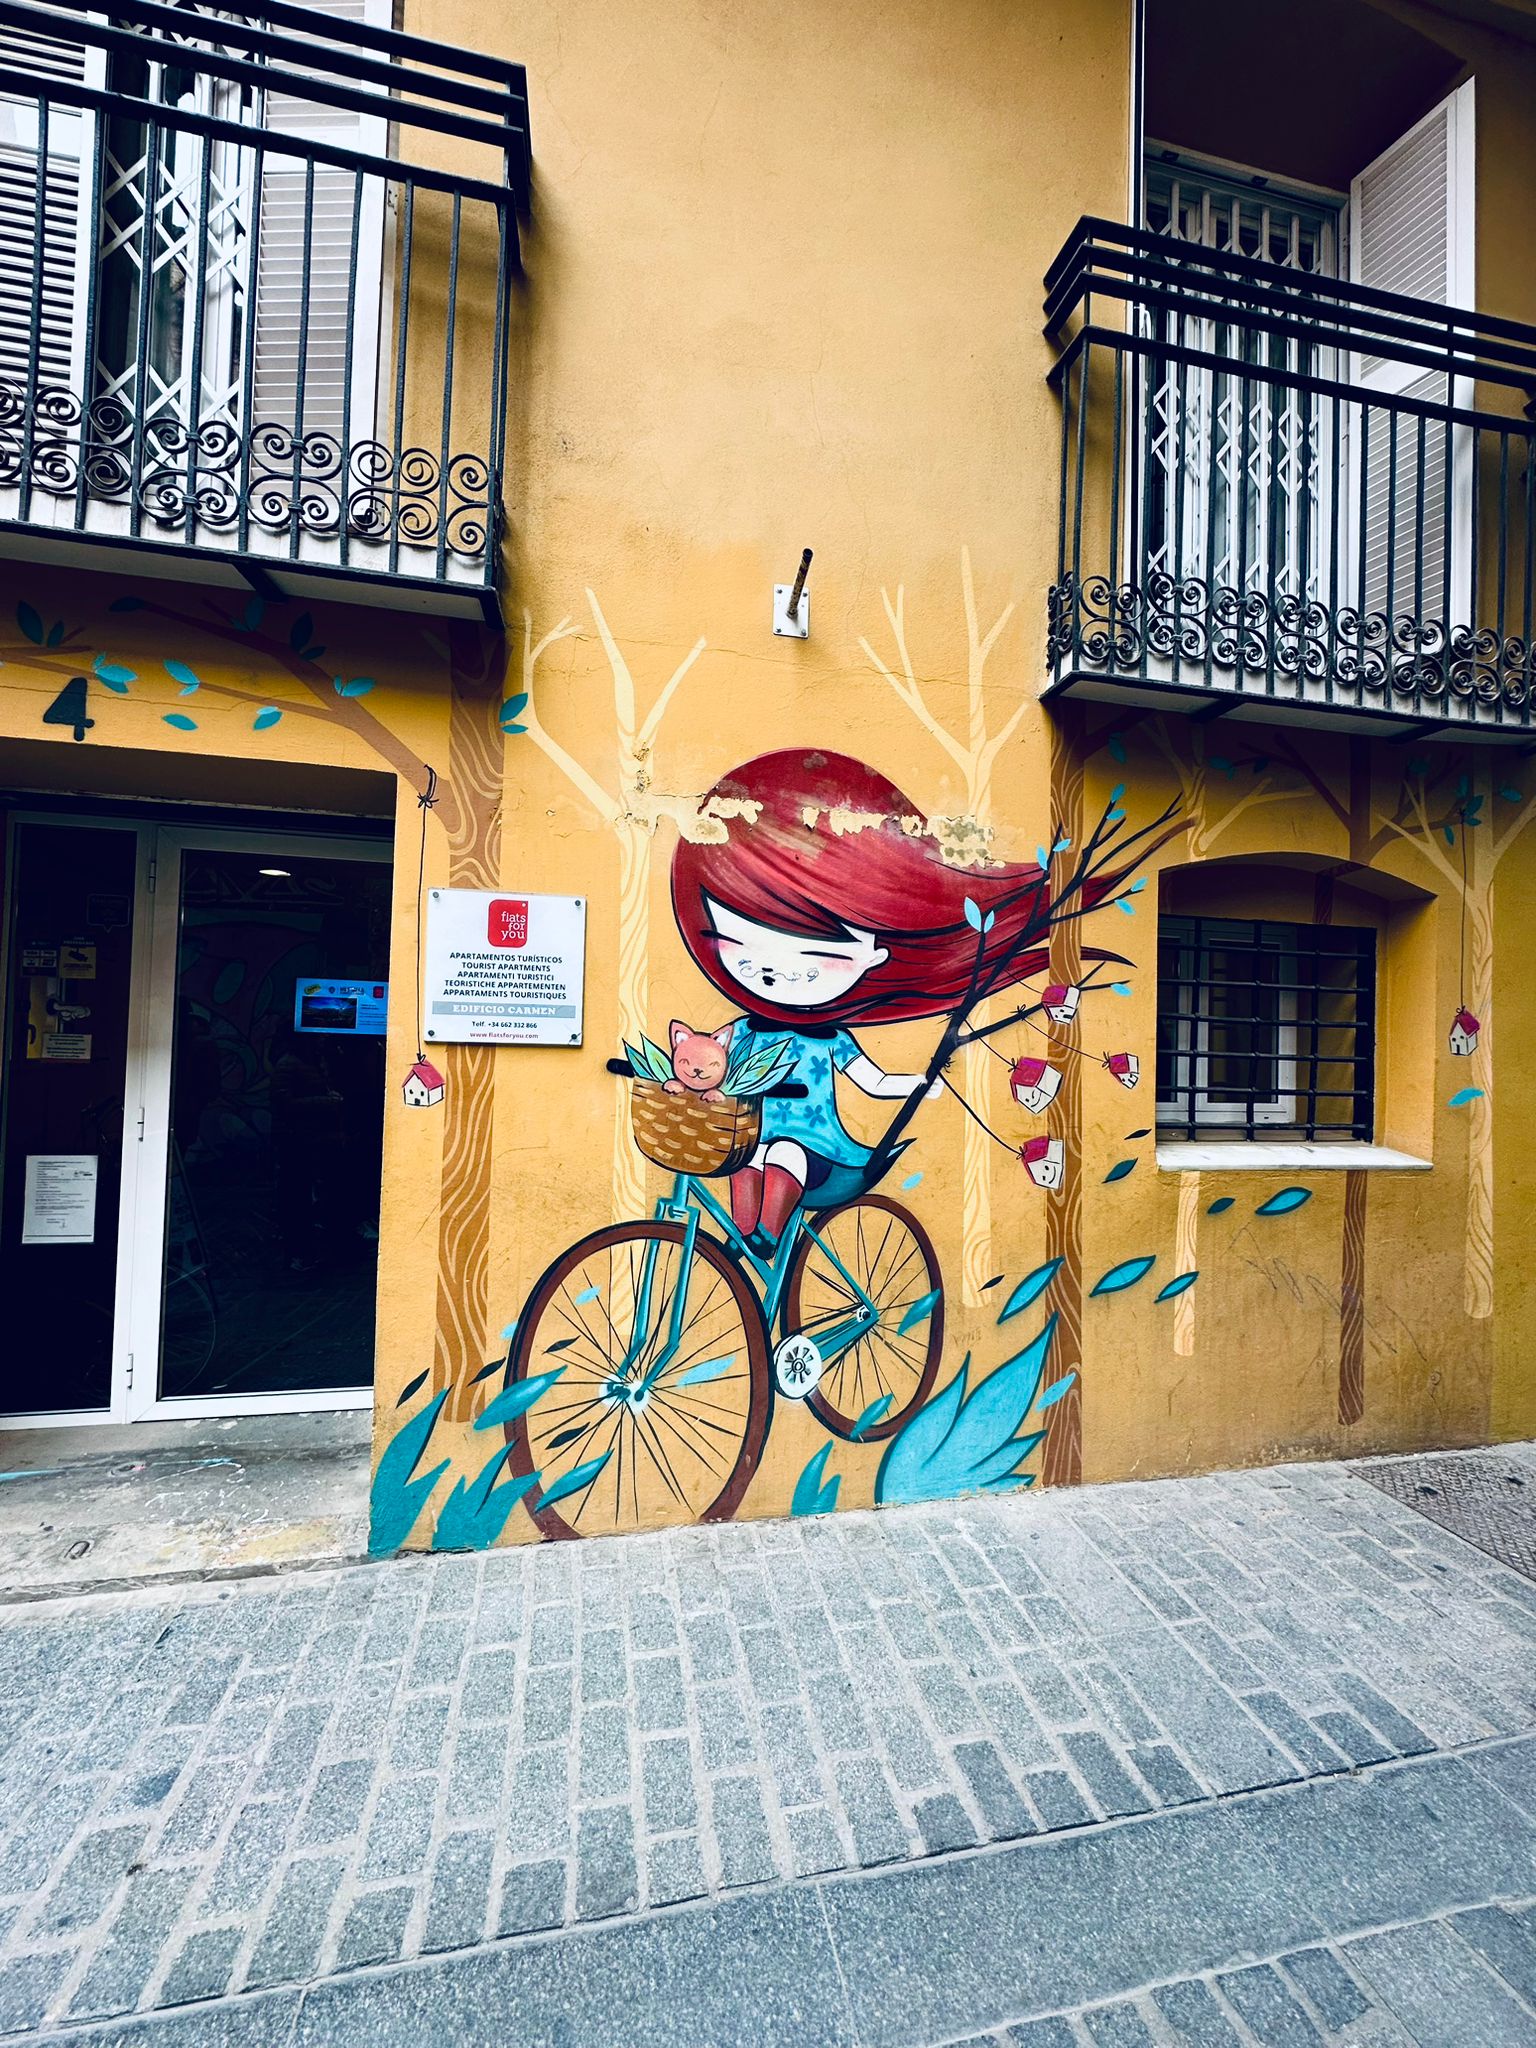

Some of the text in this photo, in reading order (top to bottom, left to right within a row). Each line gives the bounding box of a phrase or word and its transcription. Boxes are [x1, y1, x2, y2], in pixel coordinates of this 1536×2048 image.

[43, 677, 95, 742] 4
[501, 911, 526, 922] flats
[508, 922, 526, 931] for
[501, 930, 525, 941] you
[449, 952, 563, 964] APARTAMENTOS TURÍSTICOS
[462, 962, 551, 972] TOURIST APARTMENTS
[457, 971, 554, 981] APARTAMENTI TURISTICI
[445, 980, 566, 991] TEORISTICHE APPARTEMENTEN
[443, 989, 567, 1000] APPARTAMENTS TOURISTIQUES
[453, 1004, 556, 1015] EDIFICIO CARMEN
[470, 1032, 539, 1040] www.flatsforyou.com
